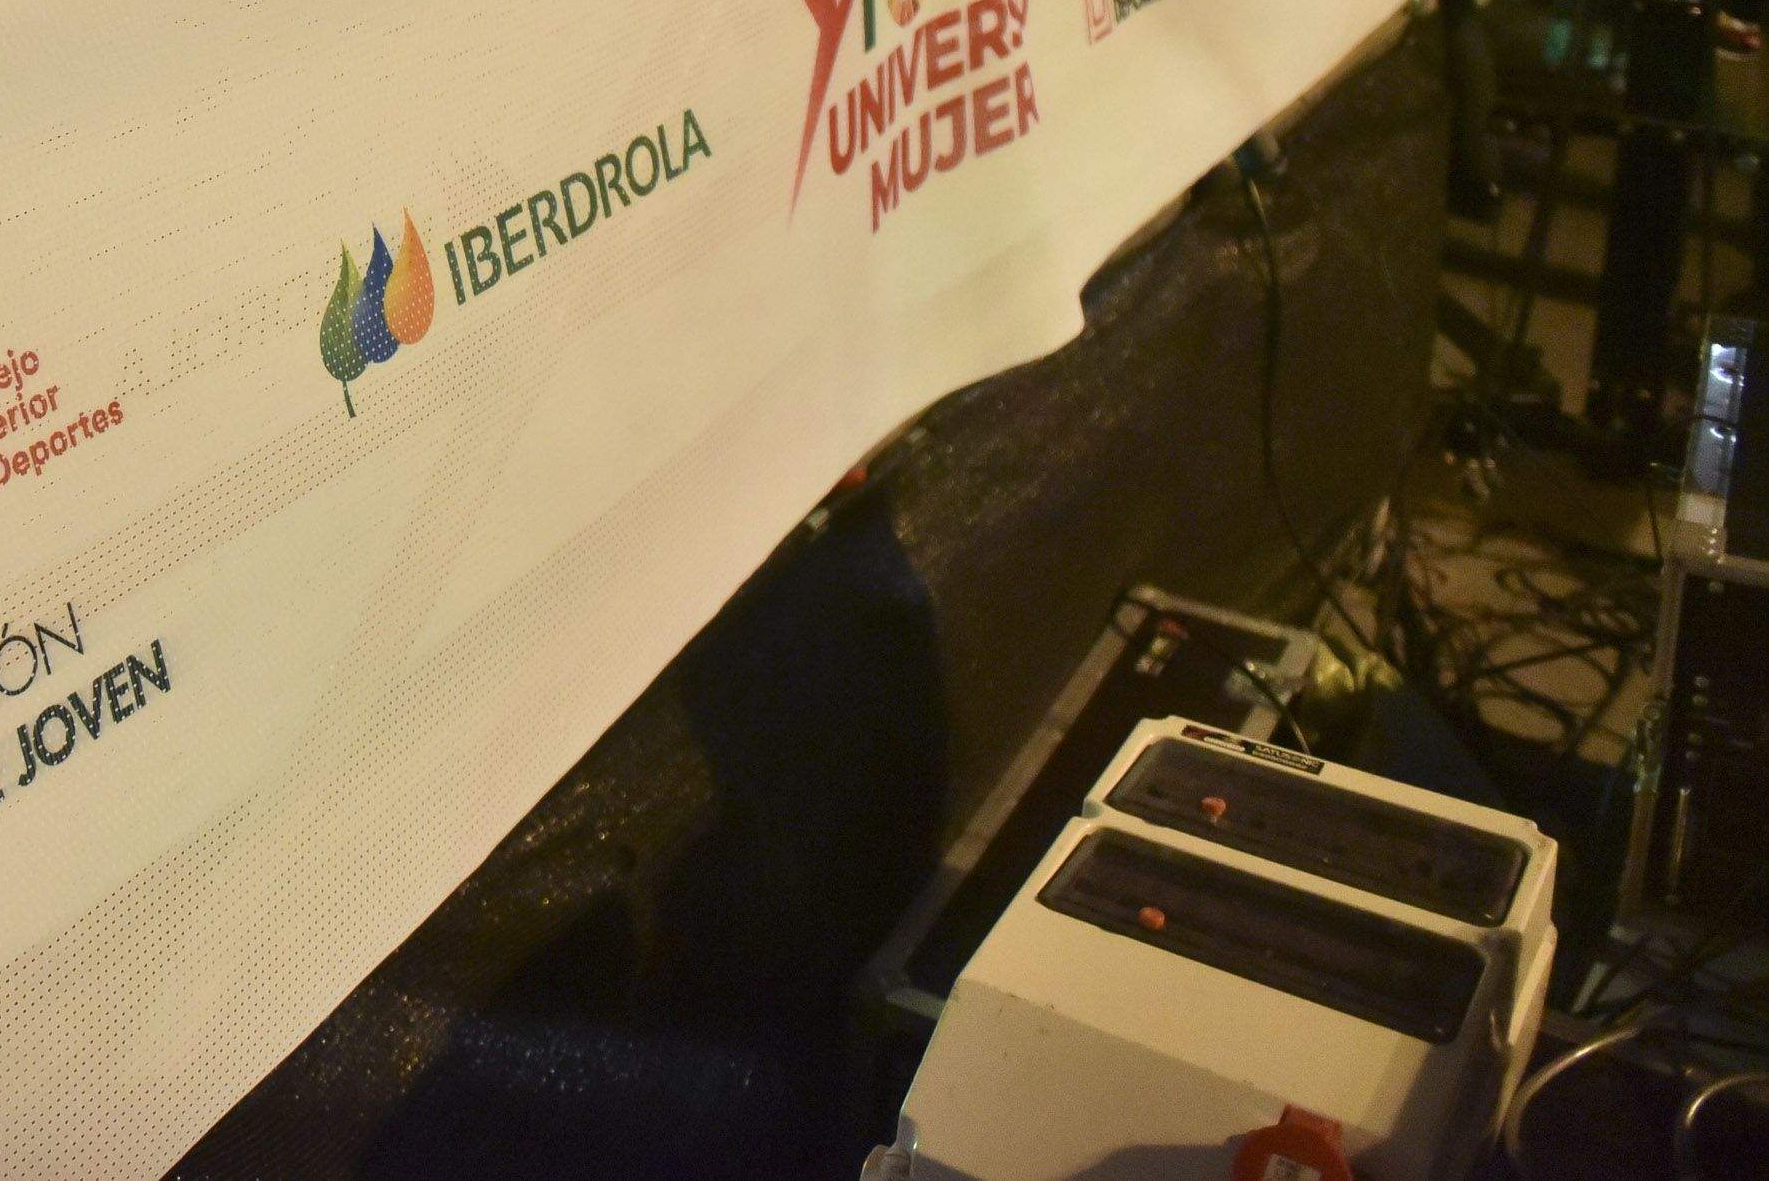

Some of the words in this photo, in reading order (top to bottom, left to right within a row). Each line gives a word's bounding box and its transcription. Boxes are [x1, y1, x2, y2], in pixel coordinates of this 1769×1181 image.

[443, 107, 712, 306] IBERDROLA
[870, 60, 1040, 235] MUJER
[17, 639, 173, 787] JOVEN
